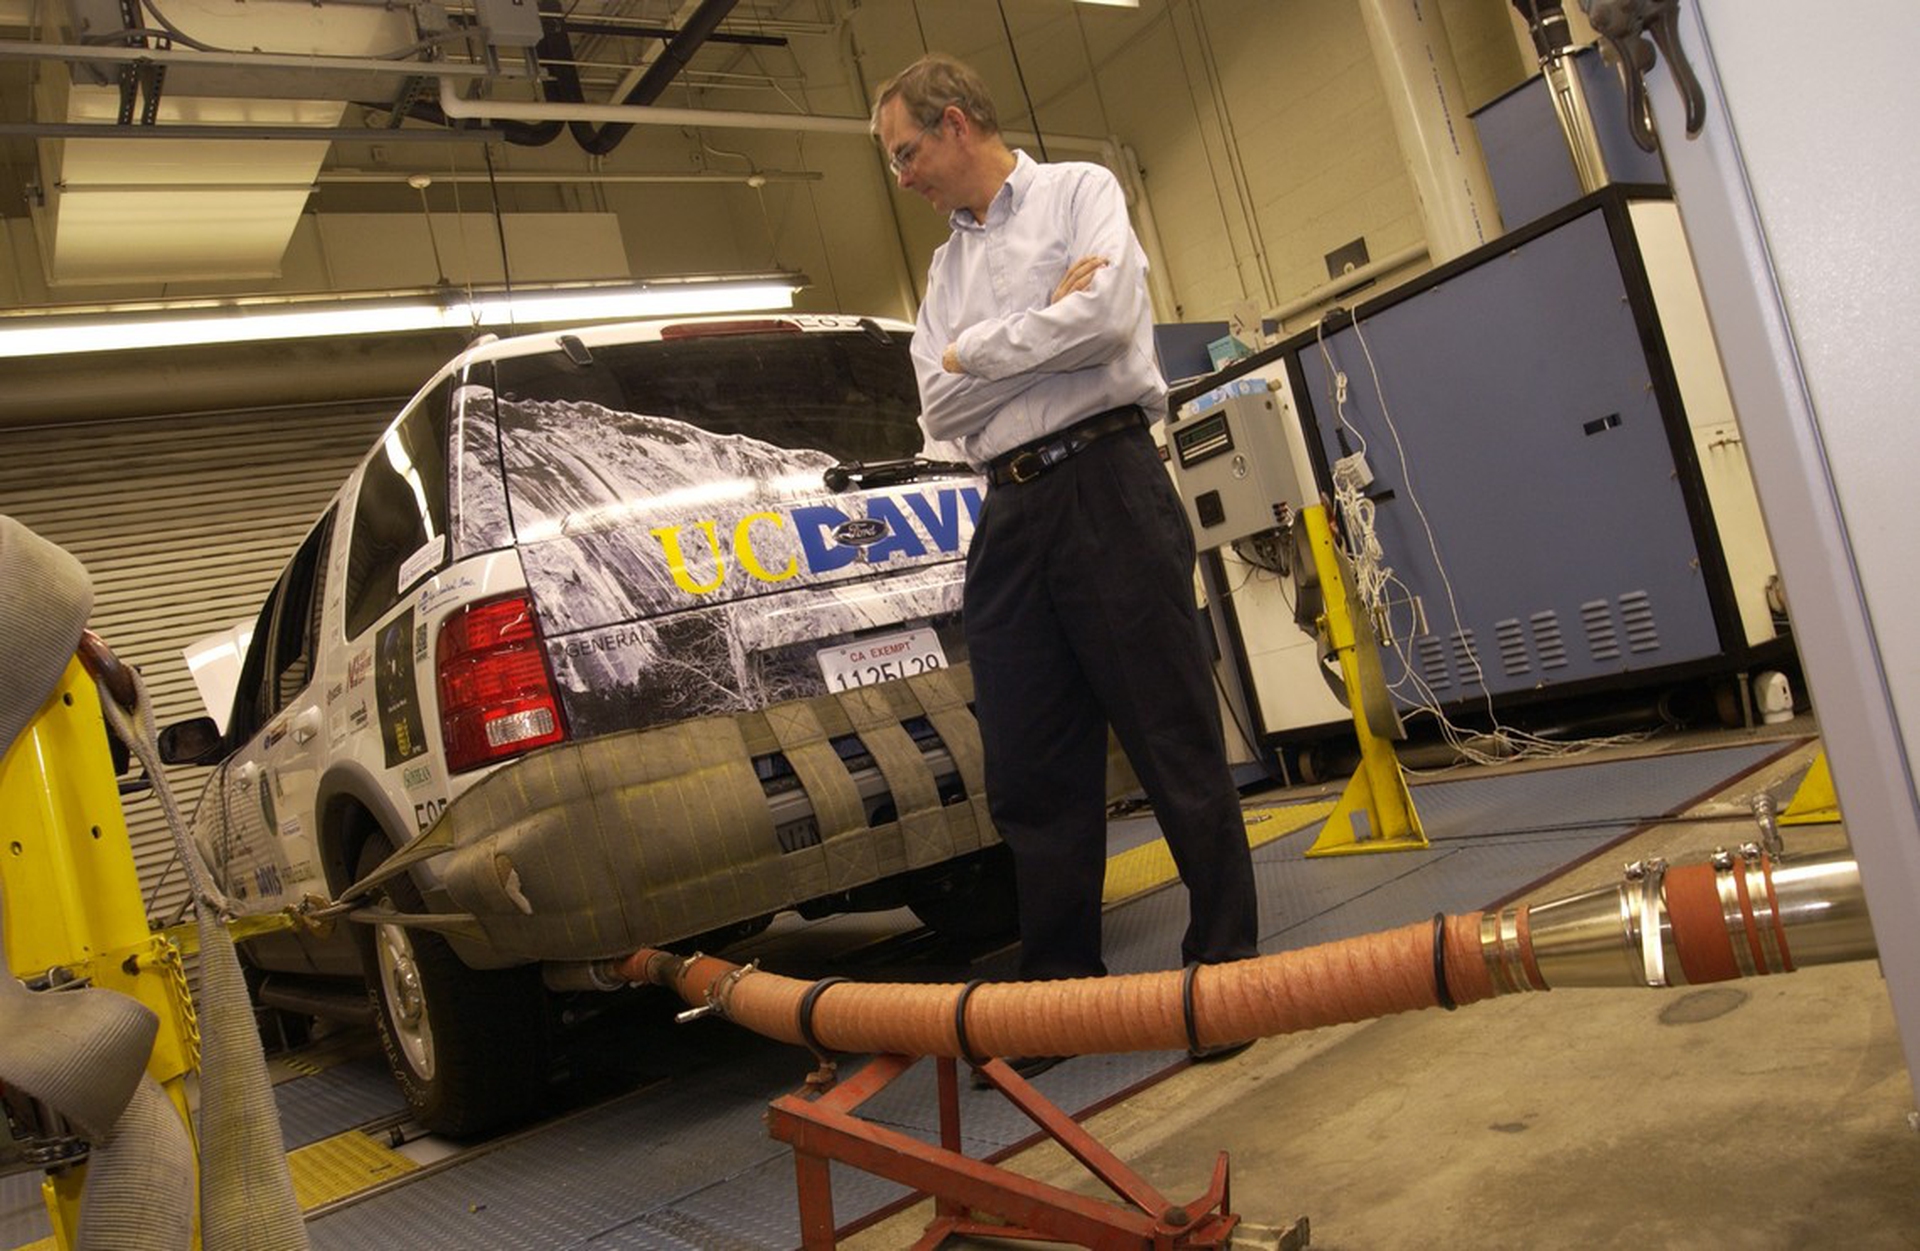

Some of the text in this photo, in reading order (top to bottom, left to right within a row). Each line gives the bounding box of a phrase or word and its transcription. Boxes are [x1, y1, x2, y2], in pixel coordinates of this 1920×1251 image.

[841, 522, 877, 540] Ford
[650, 512, 797, 594] UC
[565, 624, 652, 658] GENERAL
[850, 641, 911, 663] CA EXEMPT
